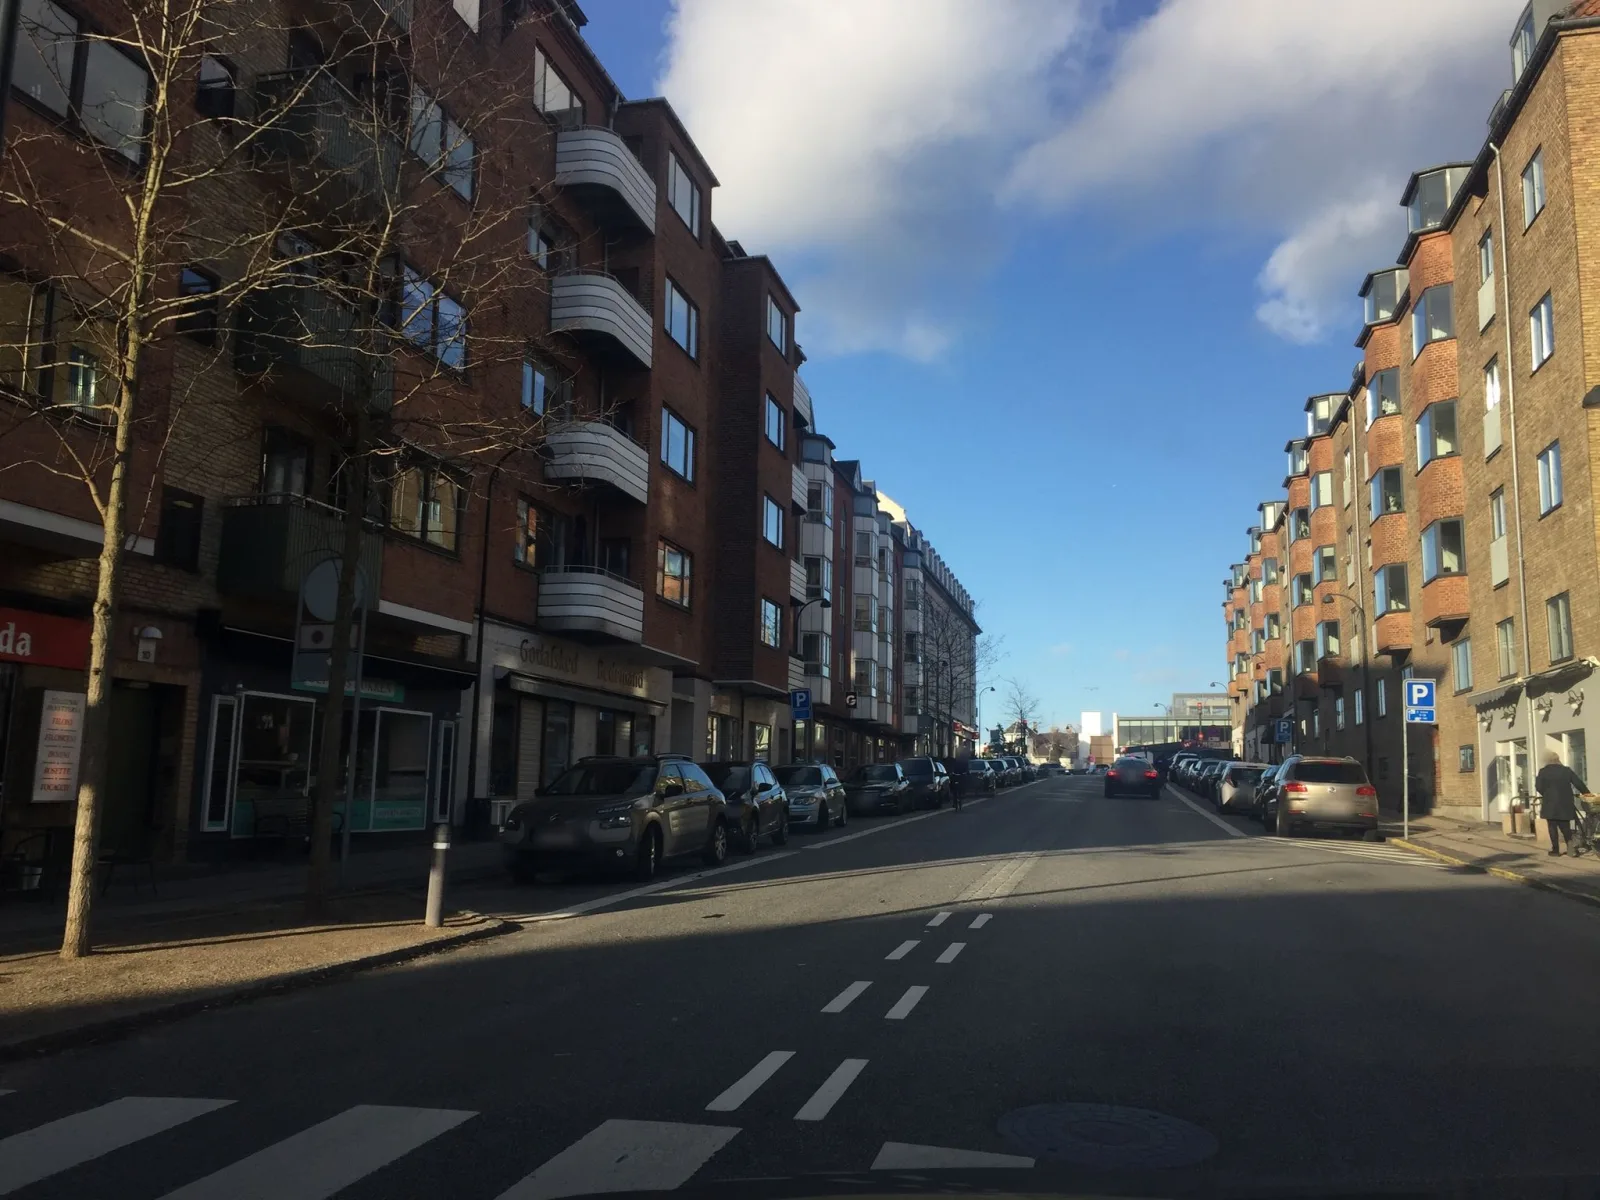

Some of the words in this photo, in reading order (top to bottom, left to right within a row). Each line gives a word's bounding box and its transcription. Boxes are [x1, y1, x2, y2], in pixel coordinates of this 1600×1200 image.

[796, 692, 807, 707] P
[846, 695, 857, 706] G
[1412, 684, 1429, 705] P
[1280, 721, 1289, 733] P
